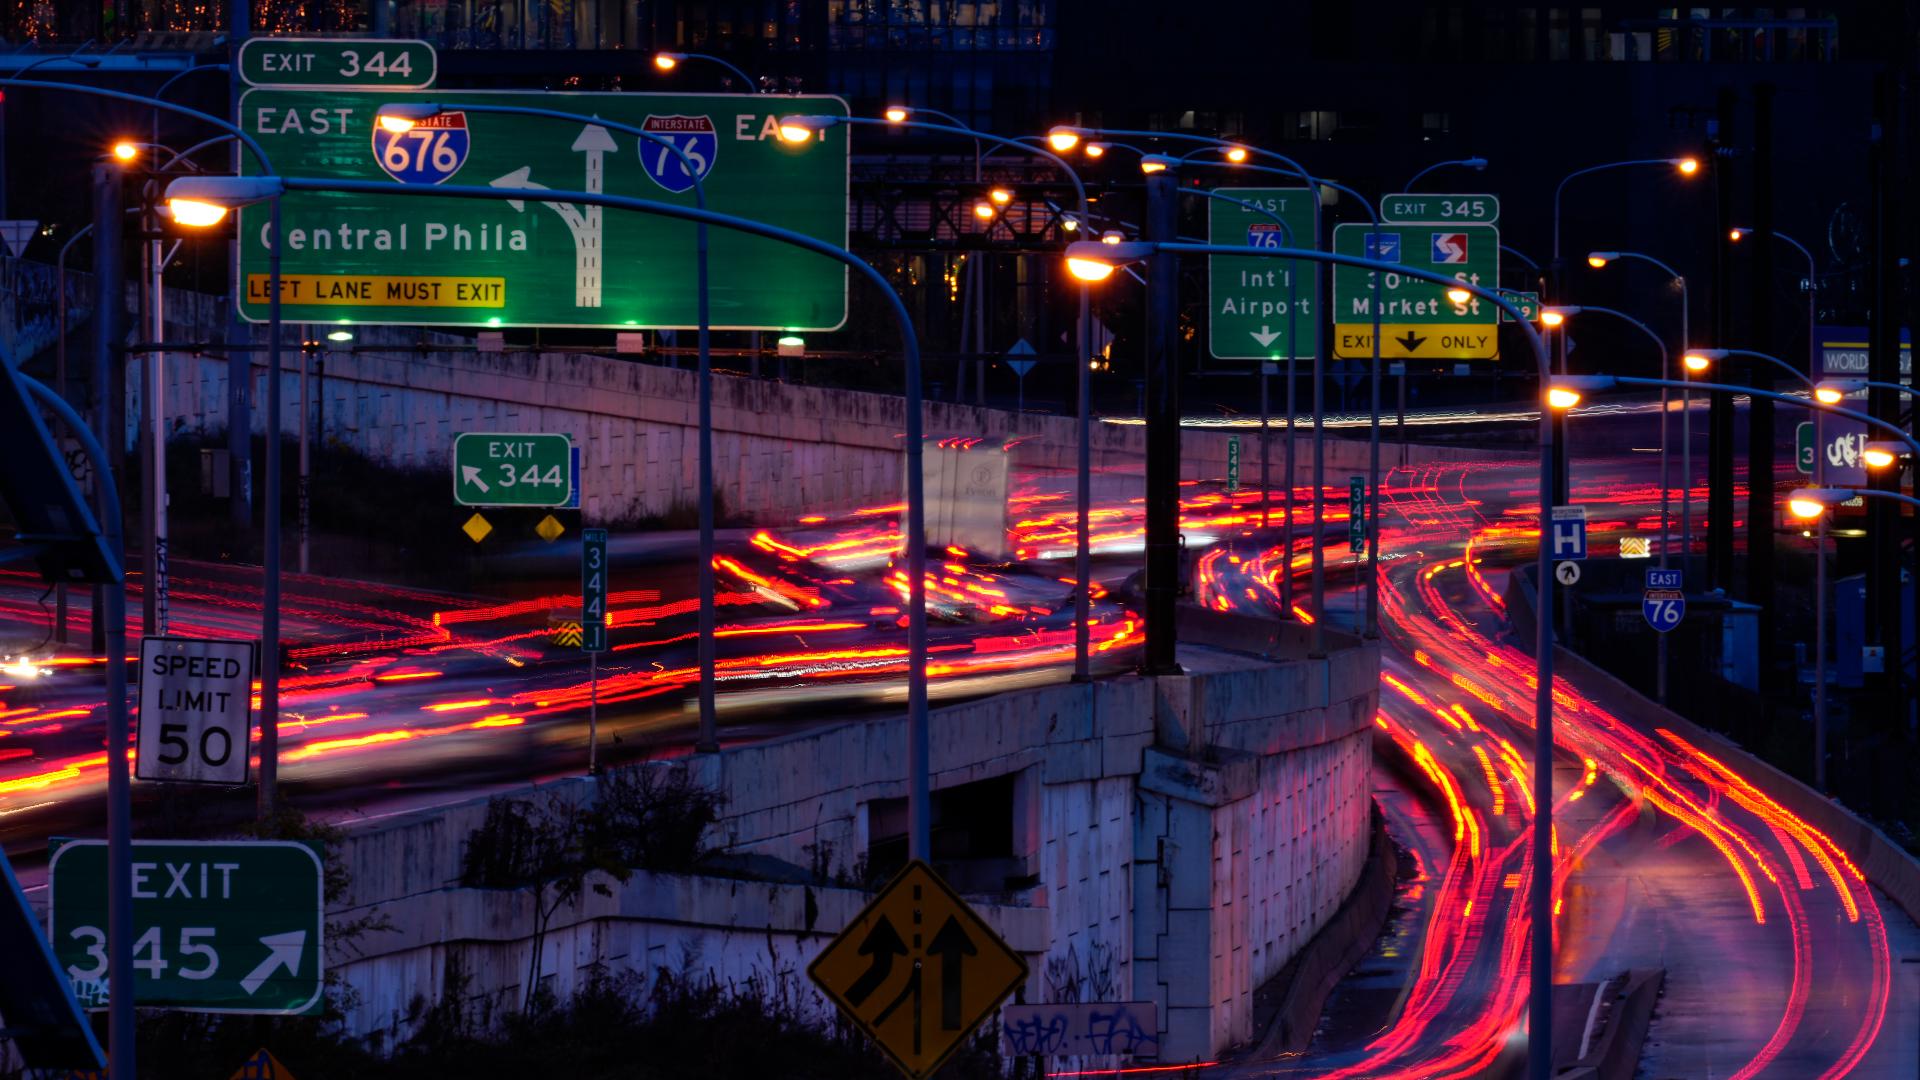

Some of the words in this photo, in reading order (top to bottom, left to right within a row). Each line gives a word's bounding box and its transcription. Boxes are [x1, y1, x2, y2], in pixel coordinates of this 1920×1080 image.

[262, 53, 316, 72] EXIT
[338, 50, 413, 78] 344
[256, 107, 353, 135] EAST
[650, 119, 706, 131] INTERSTATE
[384, 130, 458, 172] 676
[648, 136, 707, 176] 76
[1241, 198, 1288, 213] EAST
[1394, 203, 1426, 215] EXIT
[1440, 200, 1486, 217] 345
[425, 222, 528, 251] Phila
[1250, 232, 1278, 248] 76
[1241, 269, 1290, 288] Int'l
[316, 282, 372, 300] LANE
[387, 283, 442, 301] MUST
[456, 284, 502, 302] EXIT
[1221, 297, 1310, 318] Airpot
[1343, 335, 1375, 349] EXI
[1441, 335, 1488, 349] ONLY
[489, 442, 536, 459] EXIT
[498, 463, 563, 488] 344
[1554, 523, 1582, 554] H
[1650, 573, 1677, 585] EAST
[1648, 600, 1679, 623] 76
[152, 655, 240, 679] SPEED
[159, 689, 231, 713] LIMIT
[157, 724, 232, 767] 50
[131, 862, 240, 899] EXIT
[67, 925, 220, 981] 345
